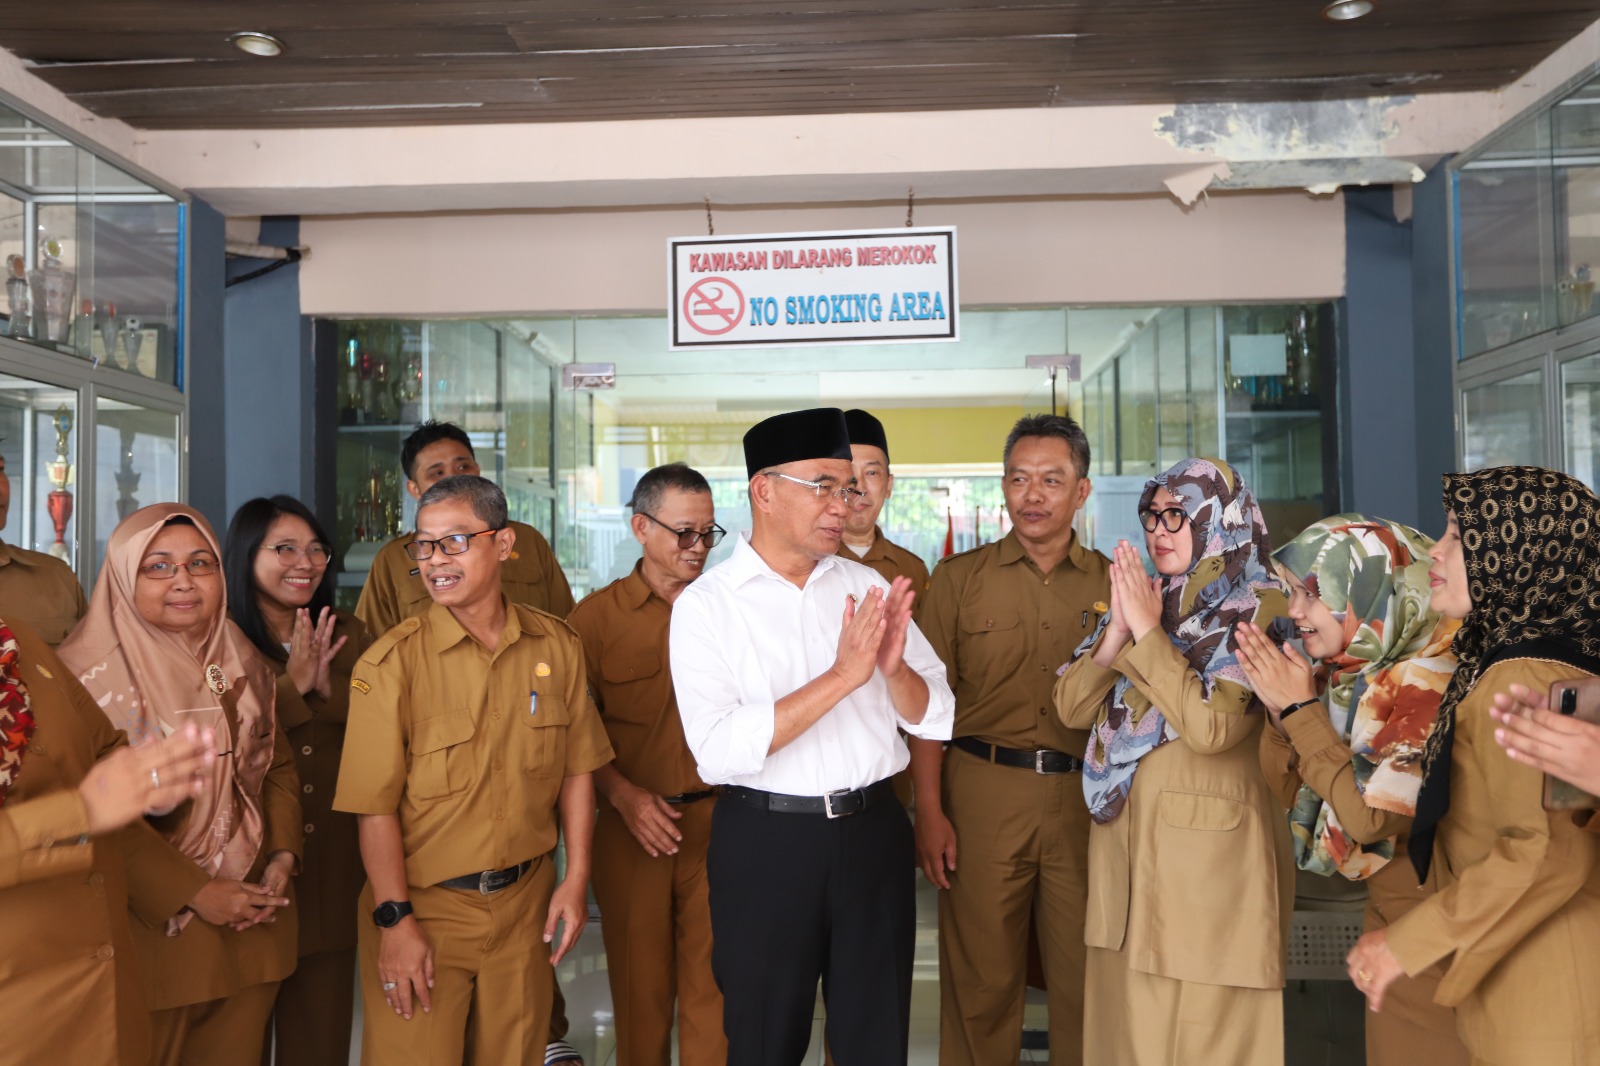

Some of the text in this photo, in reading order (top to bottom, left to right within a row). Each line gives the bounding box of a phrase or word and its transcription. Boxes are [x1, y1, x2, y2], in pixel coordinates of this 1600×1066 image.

[689, 244, 937, 273] KAWASAN DILARANG MEROKOK
[749, 291, 946, 327] NO SMOKING AREA
